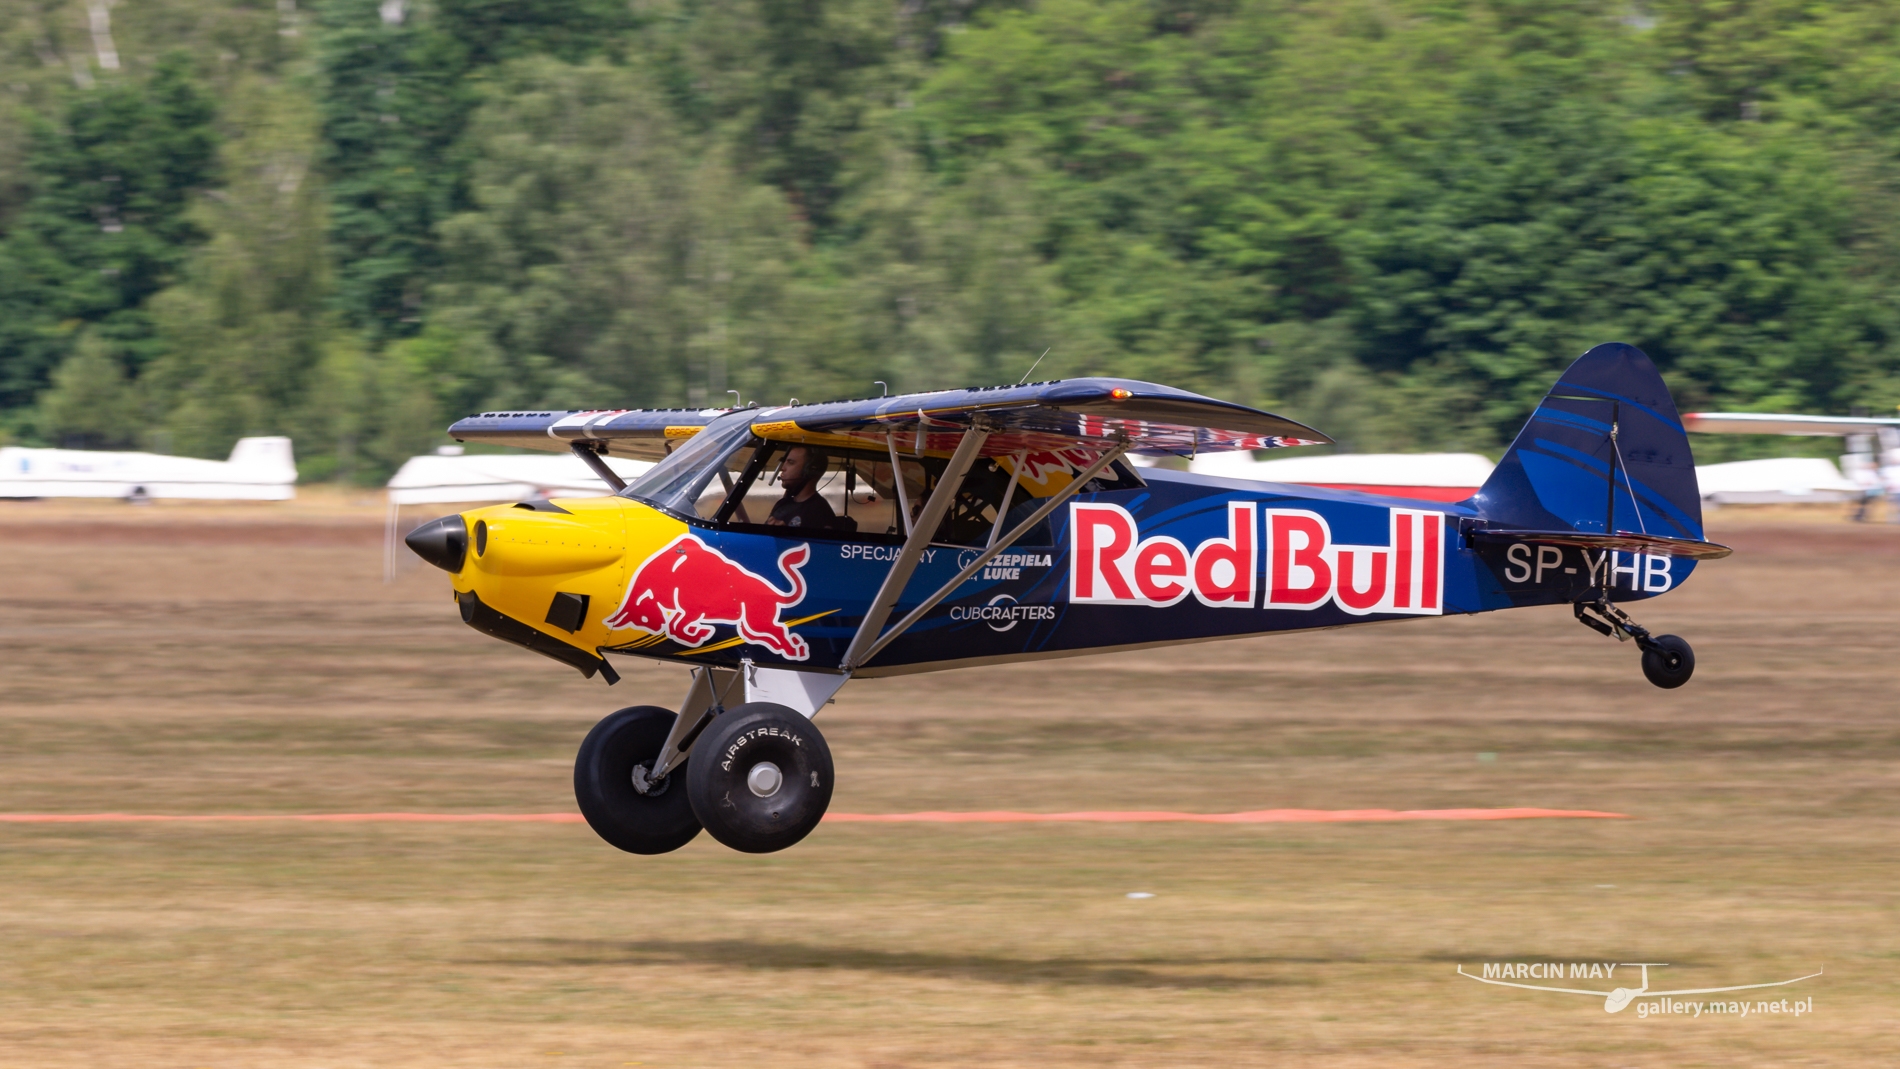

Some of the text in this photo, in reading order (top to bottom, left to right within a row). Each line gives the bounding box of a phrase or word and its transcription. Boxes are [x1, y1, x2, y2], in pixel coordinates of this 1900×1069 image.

[756, 422, 794, 432] PORSCHE
[840, 544, 937, 564] SPECJAY
[1072, 503, 1442, 613] Red Bull
[983, 567, 1021, 580] LUKE
[1504, 543, 1673, 593] SP-YHB
[950, 605, 1055, 621] CUBCRAFTERS
[721, 727, 803, 772] AIRSTREAK
